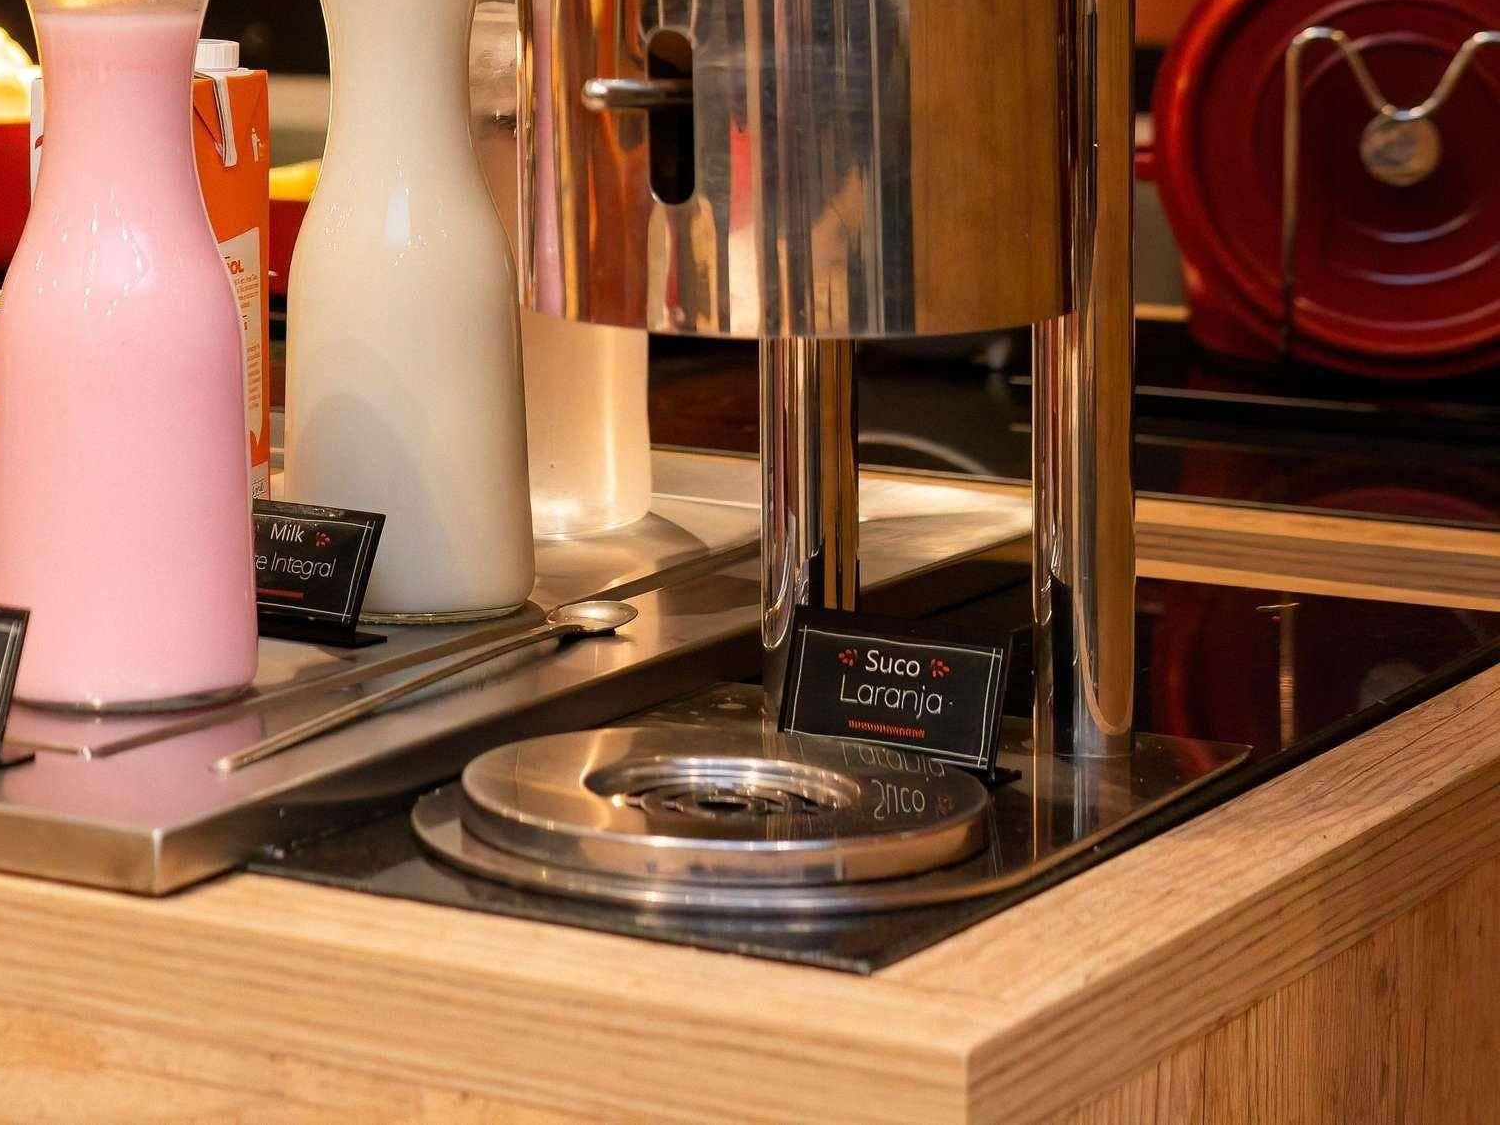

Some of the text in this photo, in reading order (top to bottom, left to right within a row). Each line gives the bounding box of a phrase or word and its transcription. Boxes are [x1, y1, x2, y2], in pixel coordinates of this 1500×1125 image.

[270, 523, 305, 543] Milk
[270, 551, 337, 581] Integral
[865, 649, 921, 677] Suco
[839, 674, 943, 719] Laranja
